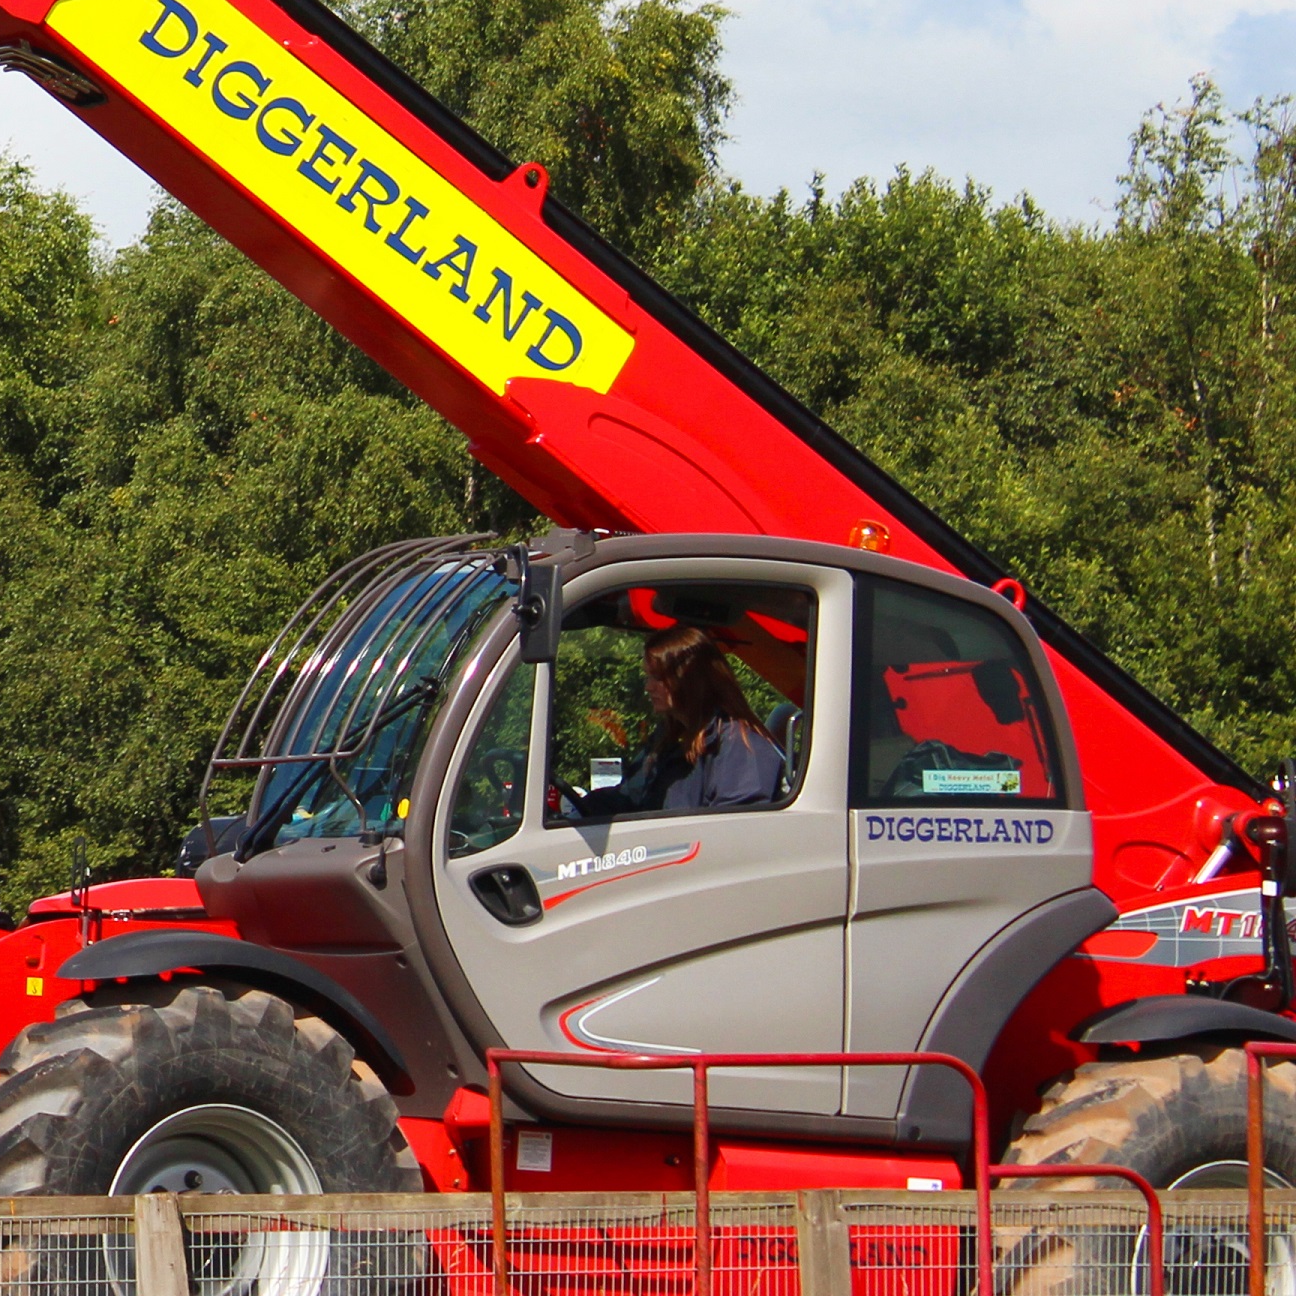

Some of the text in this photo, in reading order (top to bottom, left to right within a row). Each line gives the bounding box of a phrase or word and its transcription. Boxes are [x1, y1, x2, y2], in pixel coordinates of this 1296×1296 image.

[933, 773, 946, 782] Dig
[938, 783, 992, 792] DIGGERLAND
[865, 815, 1054, 845] DIGGERLAND
[557, 845, 648, 881] MT1840
[738, 1235, 928, 1268] DIGGLAND
